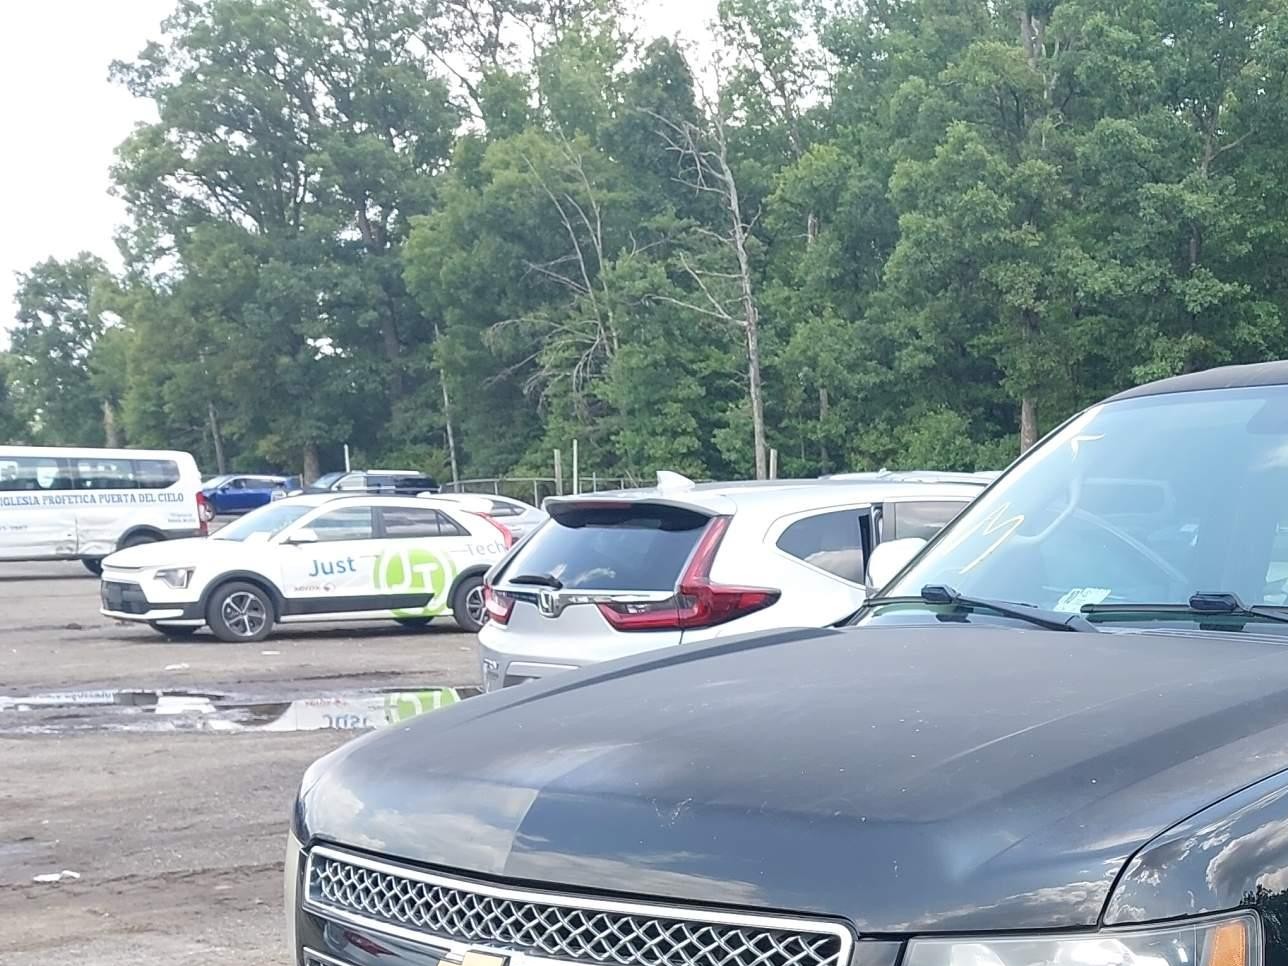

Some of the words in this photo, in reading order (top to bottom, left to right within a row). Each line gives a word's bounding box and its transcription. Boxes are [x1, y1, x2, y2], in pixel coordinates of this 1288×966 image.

[42, 493, 94, 505] PROFETICA
[99, 492, 136, 503] PUERTA
[139, 492, 157, 503] DEL
[158, 491, 184, 502] CIELO
[308, 556, 357, 577] Just
